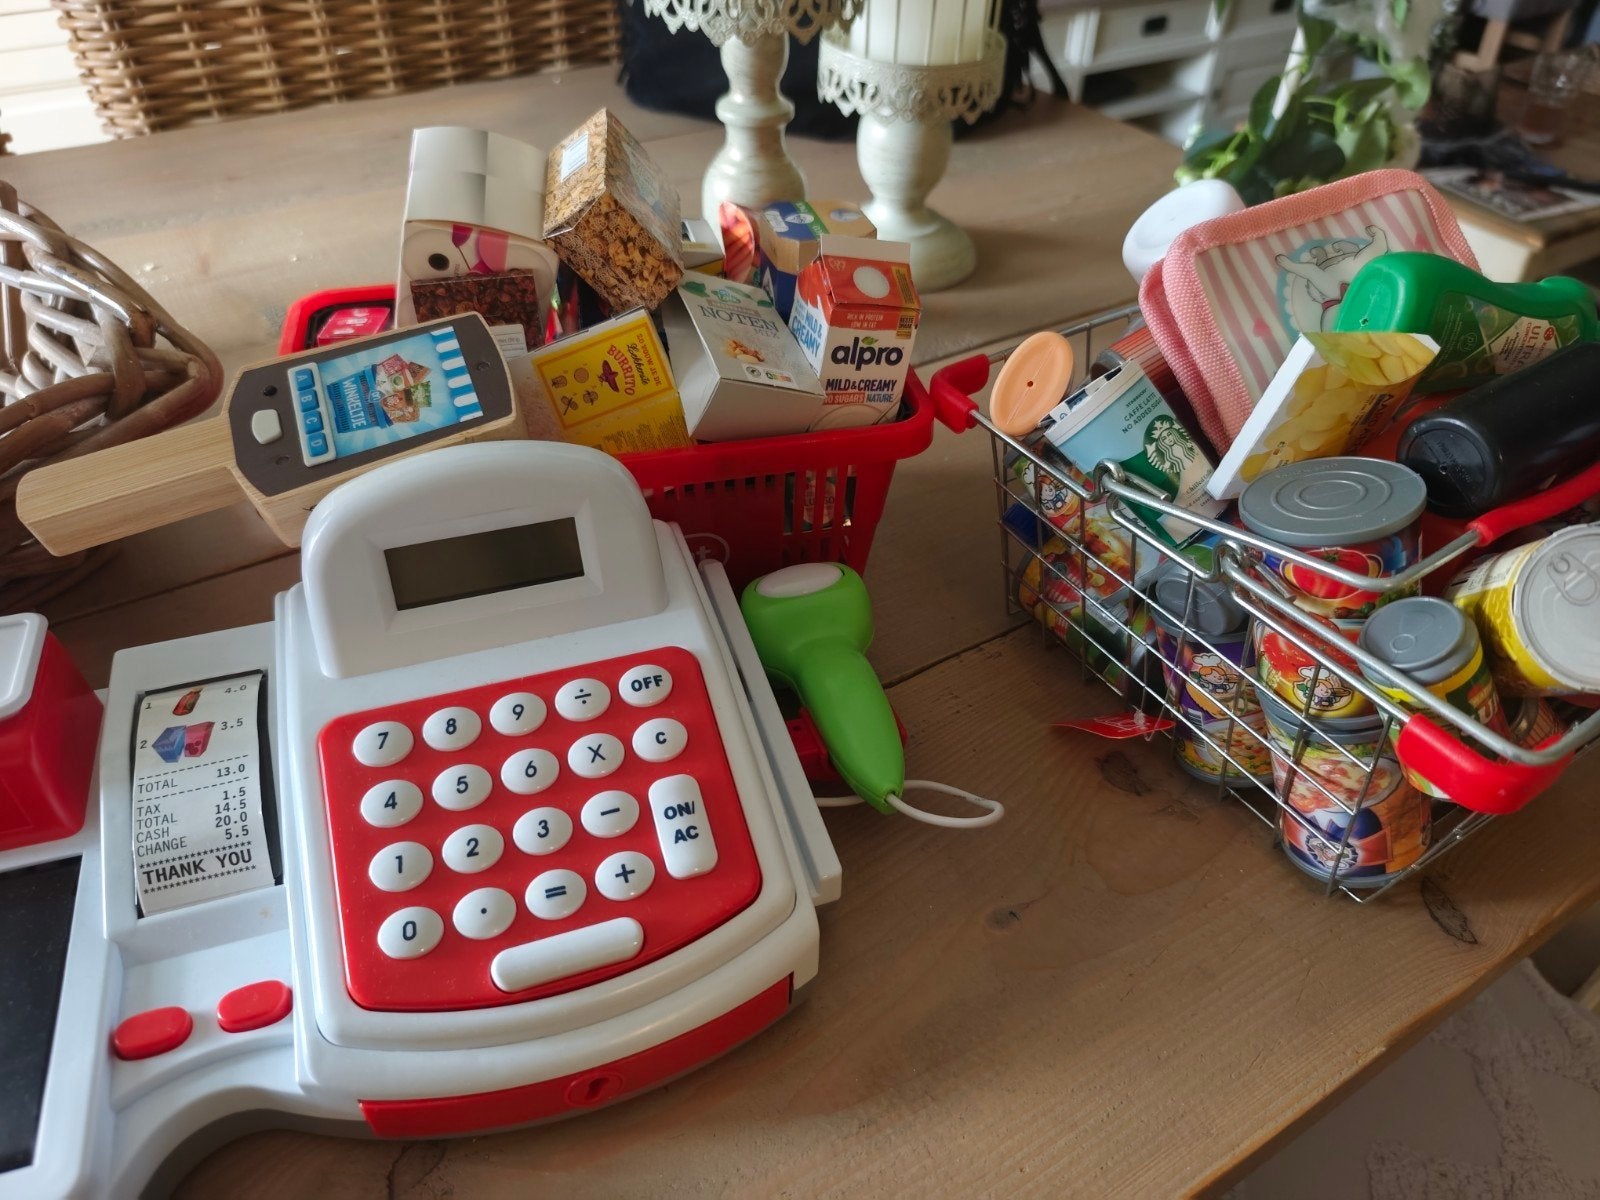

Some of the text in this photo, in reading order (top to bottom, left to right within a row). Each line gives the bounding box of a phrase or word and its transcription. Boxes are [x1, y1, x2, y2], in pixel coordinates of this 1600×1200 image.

[698, 305, 779, 332] NOTEN
[805, 310, 818, 334] MILD
[792, 316, 821, 358] CREAMY
[831, 337, 904, 371] alpro
[607, 344, 636, 396] BURRITO
[300, 394, 312, 402] B
[342, 377, 367, 430] WINKELTJE
[834, 394, 864, 404] SUGARS
[866, 394, 894, 404] NATURE
[306, 417, 318, 425] C
[1122, 424, 1133, 434] NO
[1133, 407, 1152, 425] ADDED
[312, 438, 322, 447] D
[224, 684, 247, 694] 4.0
[631, 674, 664, 692] OFF
[145, 702, 152, 710] 1
[512, 704, 524, 720] 9
[220, 718, 244, 731] 3.5
[445, 718, 457, 736] 8
[139, 740, 148, 750] 2
[378, 732, 389, 750] 7
[525, 760, 538, 778] 6
[138, 764, 246, 794] TOTAL 13.0
[456, 776, 469, 794] 5
[137, 786, 246, 817] TAX 1.5
[384, 792, 398, 810] 4
[664, 800, 696, 821] ON/
[137, 800, 248, 830] TOTAL 14.5
[136, 812, 248, 844] CASH 20.0
[537, 820, 550, 838] 3
[674, 825, 700, 844] AC
[137, 825, 250, 858] CHANGE 5.5
[466, 838, 480, 858] 2
[143, 848, 252, 886] THANK YOU
[395, 855, 404, 874] 1
